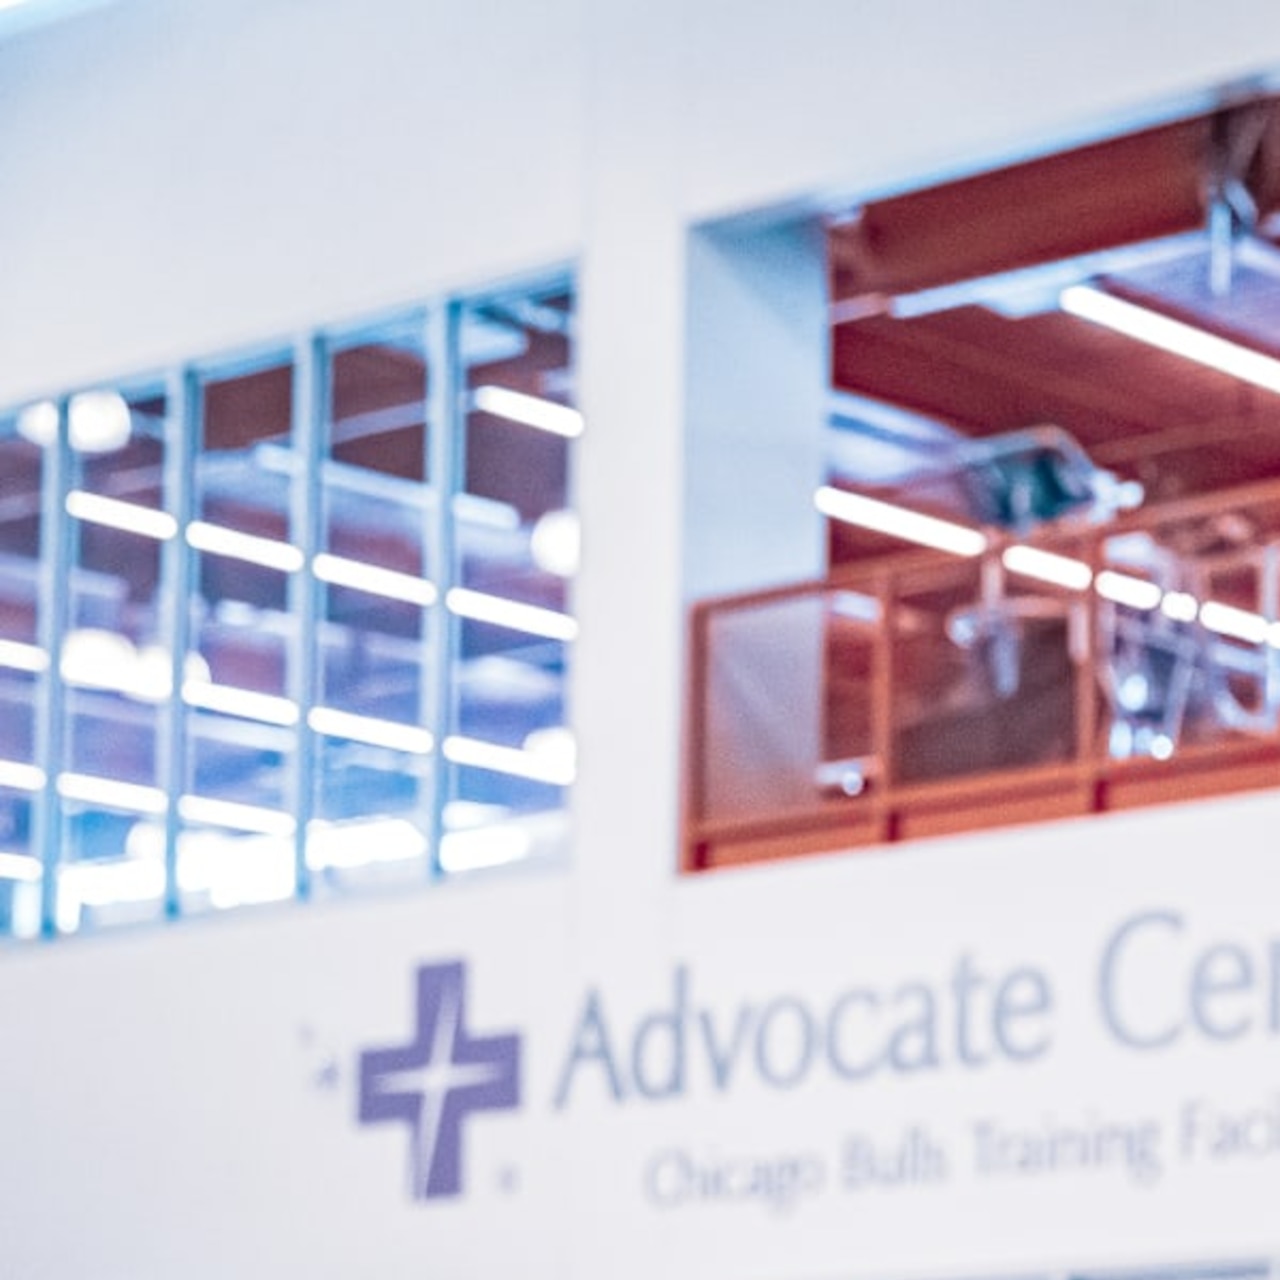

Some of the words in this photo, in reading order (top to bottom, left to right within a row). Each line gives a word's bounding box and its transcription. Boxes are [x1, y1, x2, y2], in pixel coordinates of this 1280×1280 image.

[550, 954, 1053, 1112] Advocate
[643, 1146, 826, 1218] Chicago
[842, 1126, 946, 1190] Bulls
[972, 1118, 1162, 1188] Training
